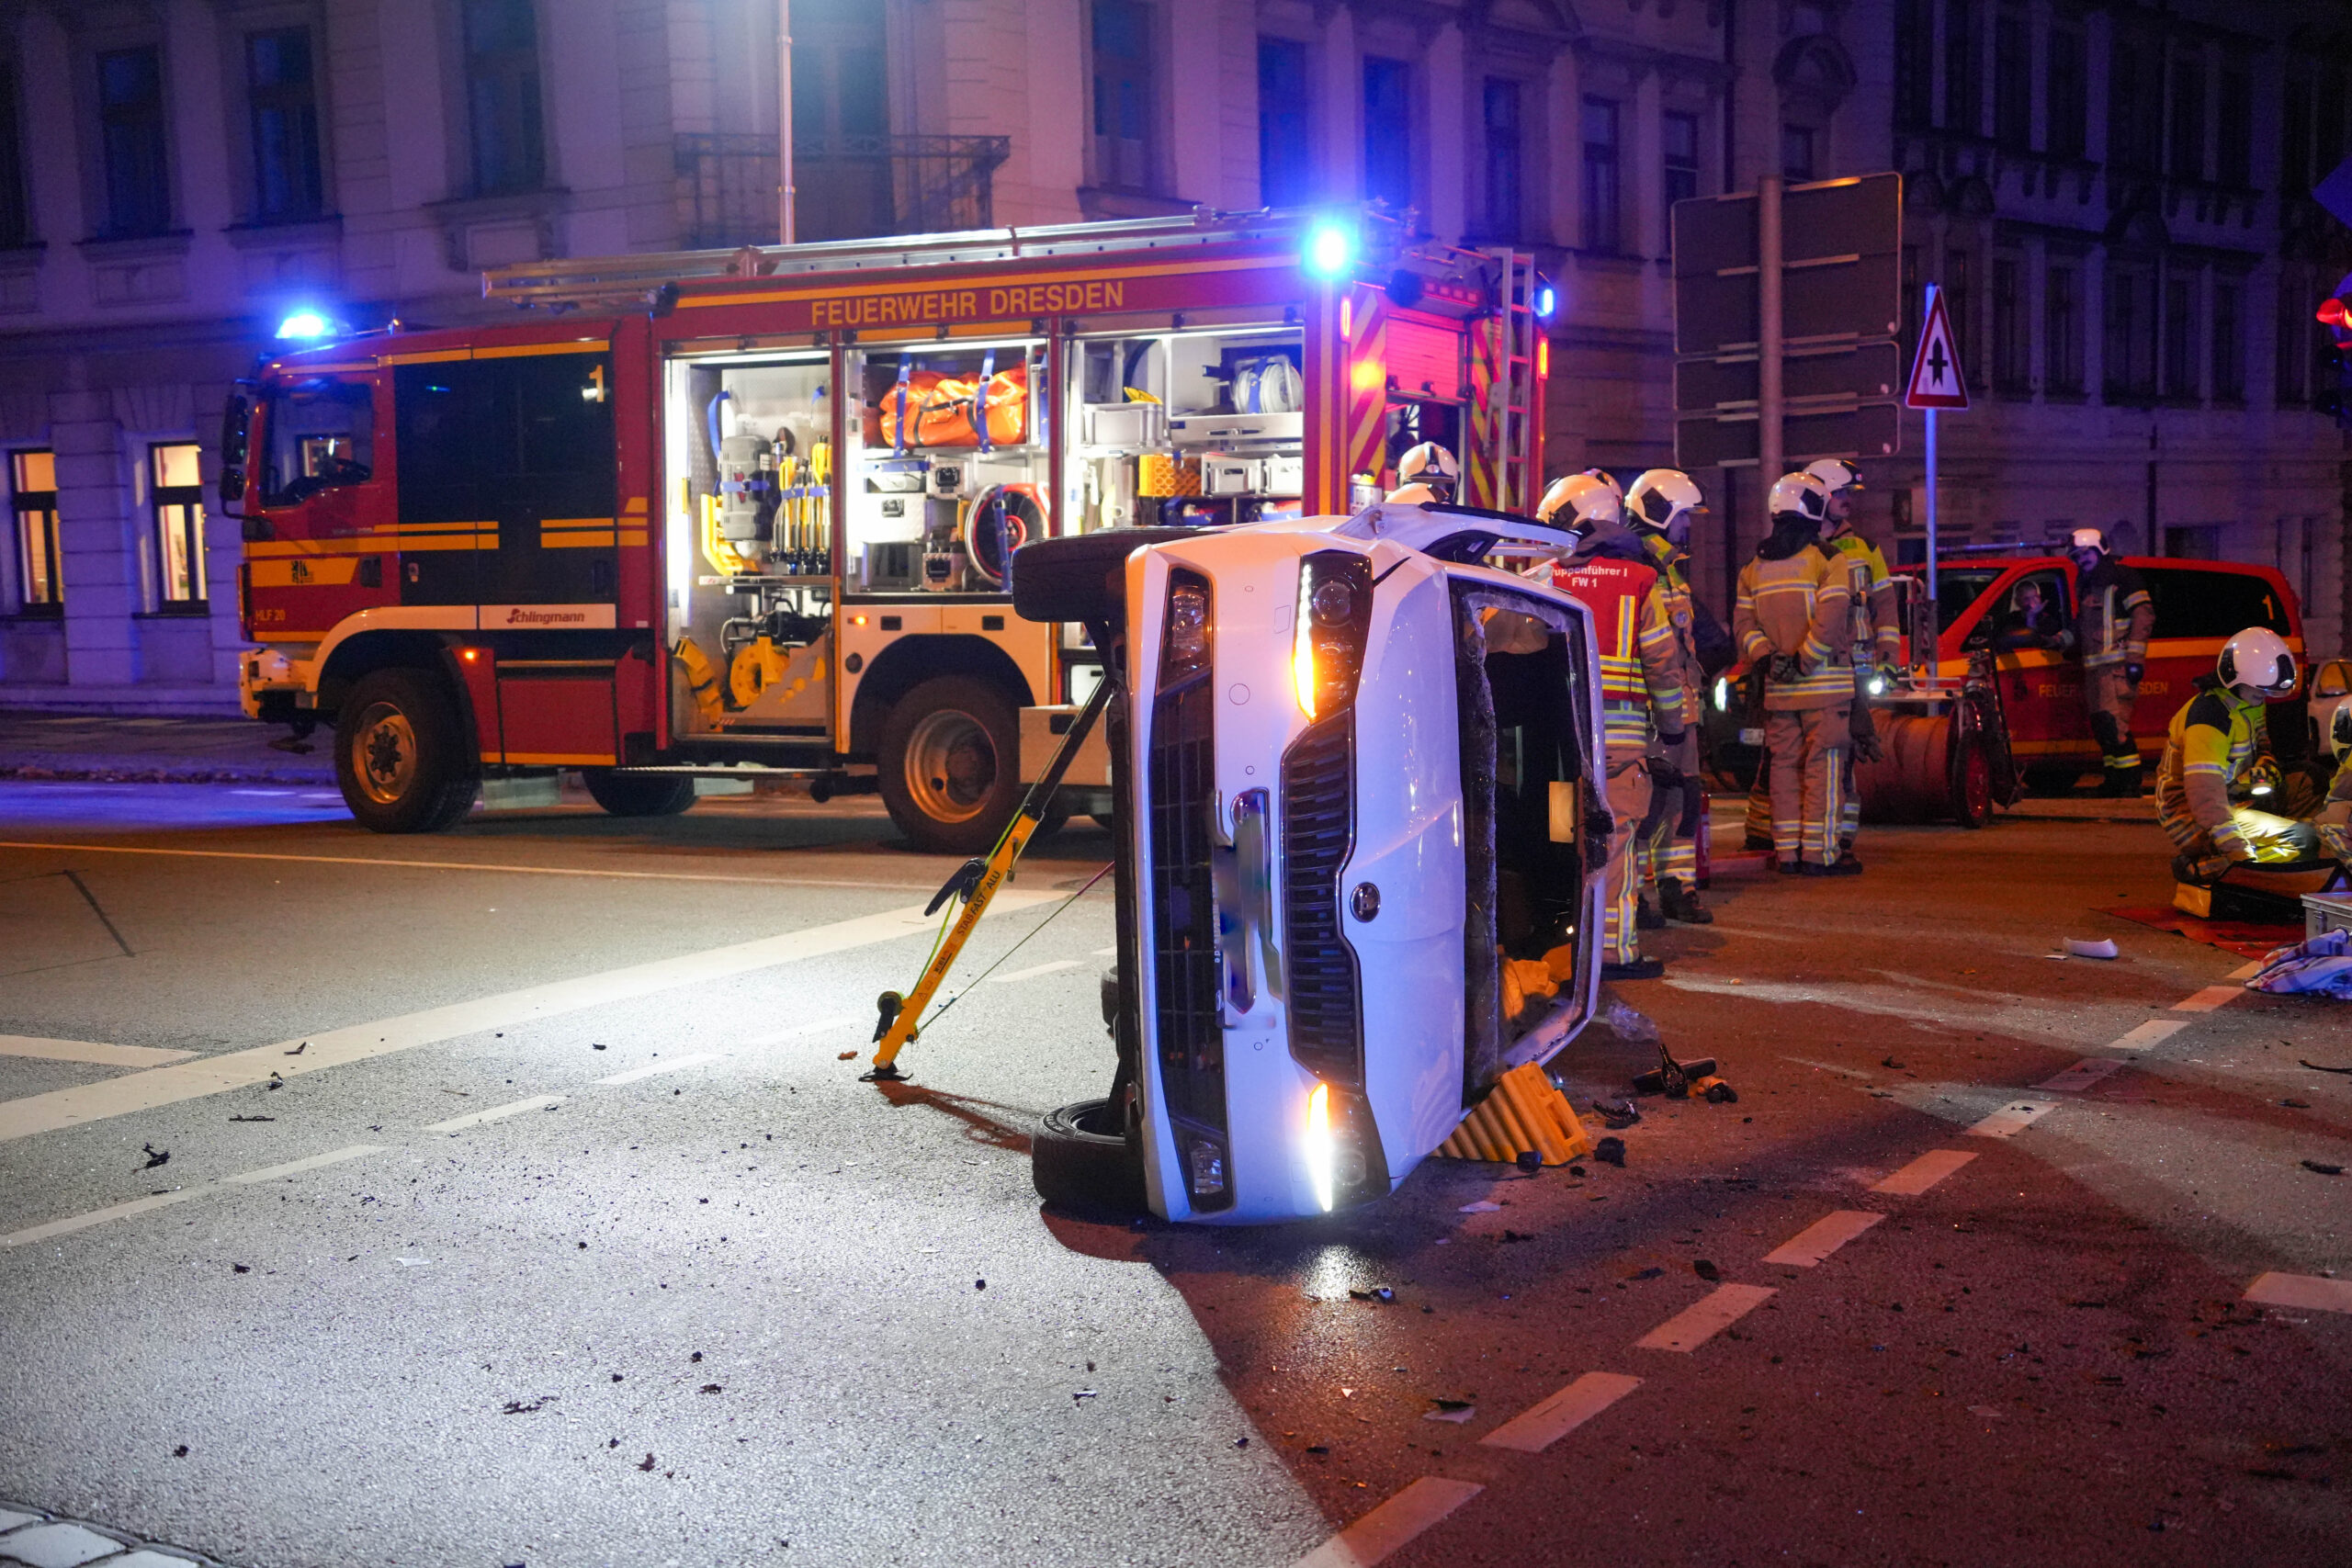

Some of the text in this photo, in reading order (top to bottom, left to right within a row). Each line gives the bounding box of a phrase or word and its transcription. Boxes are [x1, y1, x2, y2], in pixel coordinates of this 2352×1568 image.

[811, 281, 1124, 325] FEUERWEHR DRESDEN
[589, 365, 604, 402] 1
[1572, 577, 1598, 588] FW 1
[506, 608, 585, 625] Schlingmann
[2262, 594, 2274, 620] 1
[2138, 682, 2168, 695] SDEN
[986, 871, 1001, 890] ALU
